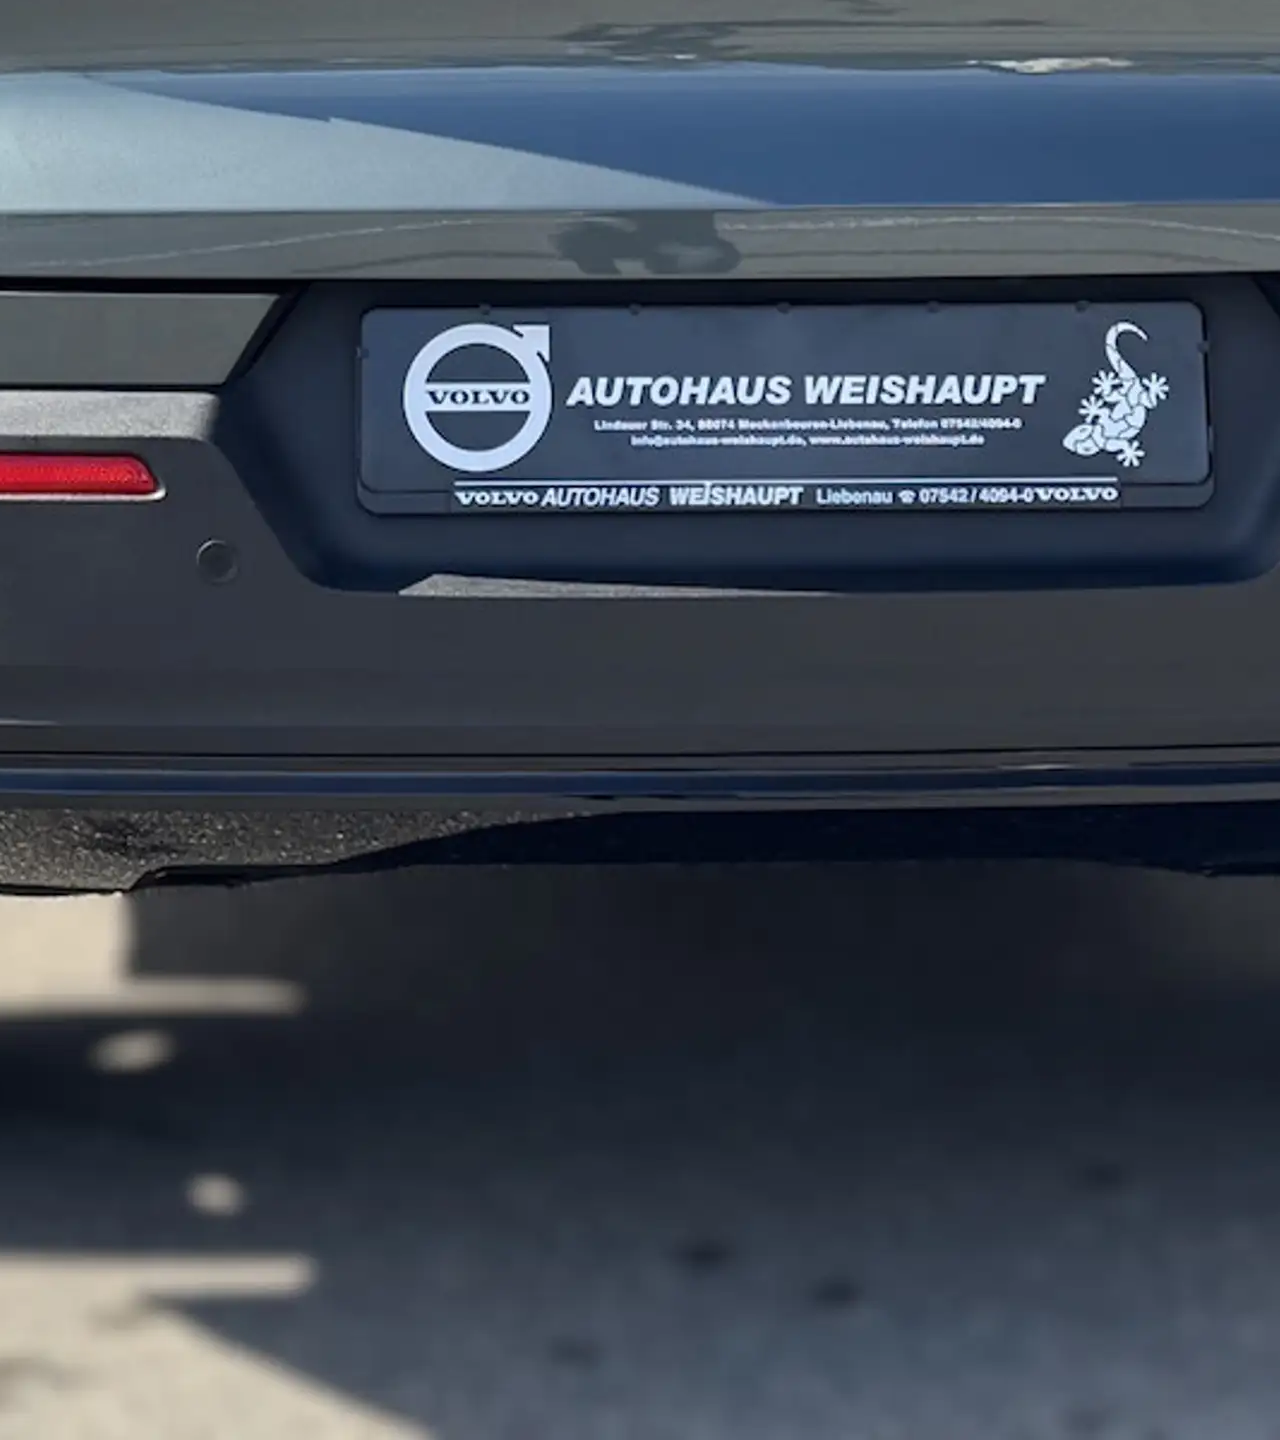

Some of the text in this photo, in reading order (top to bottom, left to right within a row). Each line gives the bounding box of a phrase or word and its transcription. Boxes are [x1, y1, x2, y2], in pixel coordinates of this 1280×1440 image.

[427, 389, 530, 405] VOLVO
[566, 375, 1046, 406] AUTOHAUS WEISHAUPT
[454, 491, 540, 507] VOLVO
[541, 487, 661, 507] AUTOHAUS
[669, 486, 804, 506] WEISHAUPT
[816, 487, 894, 505] Liebenau
[1035, 487, 1118, 501] VOLVO
